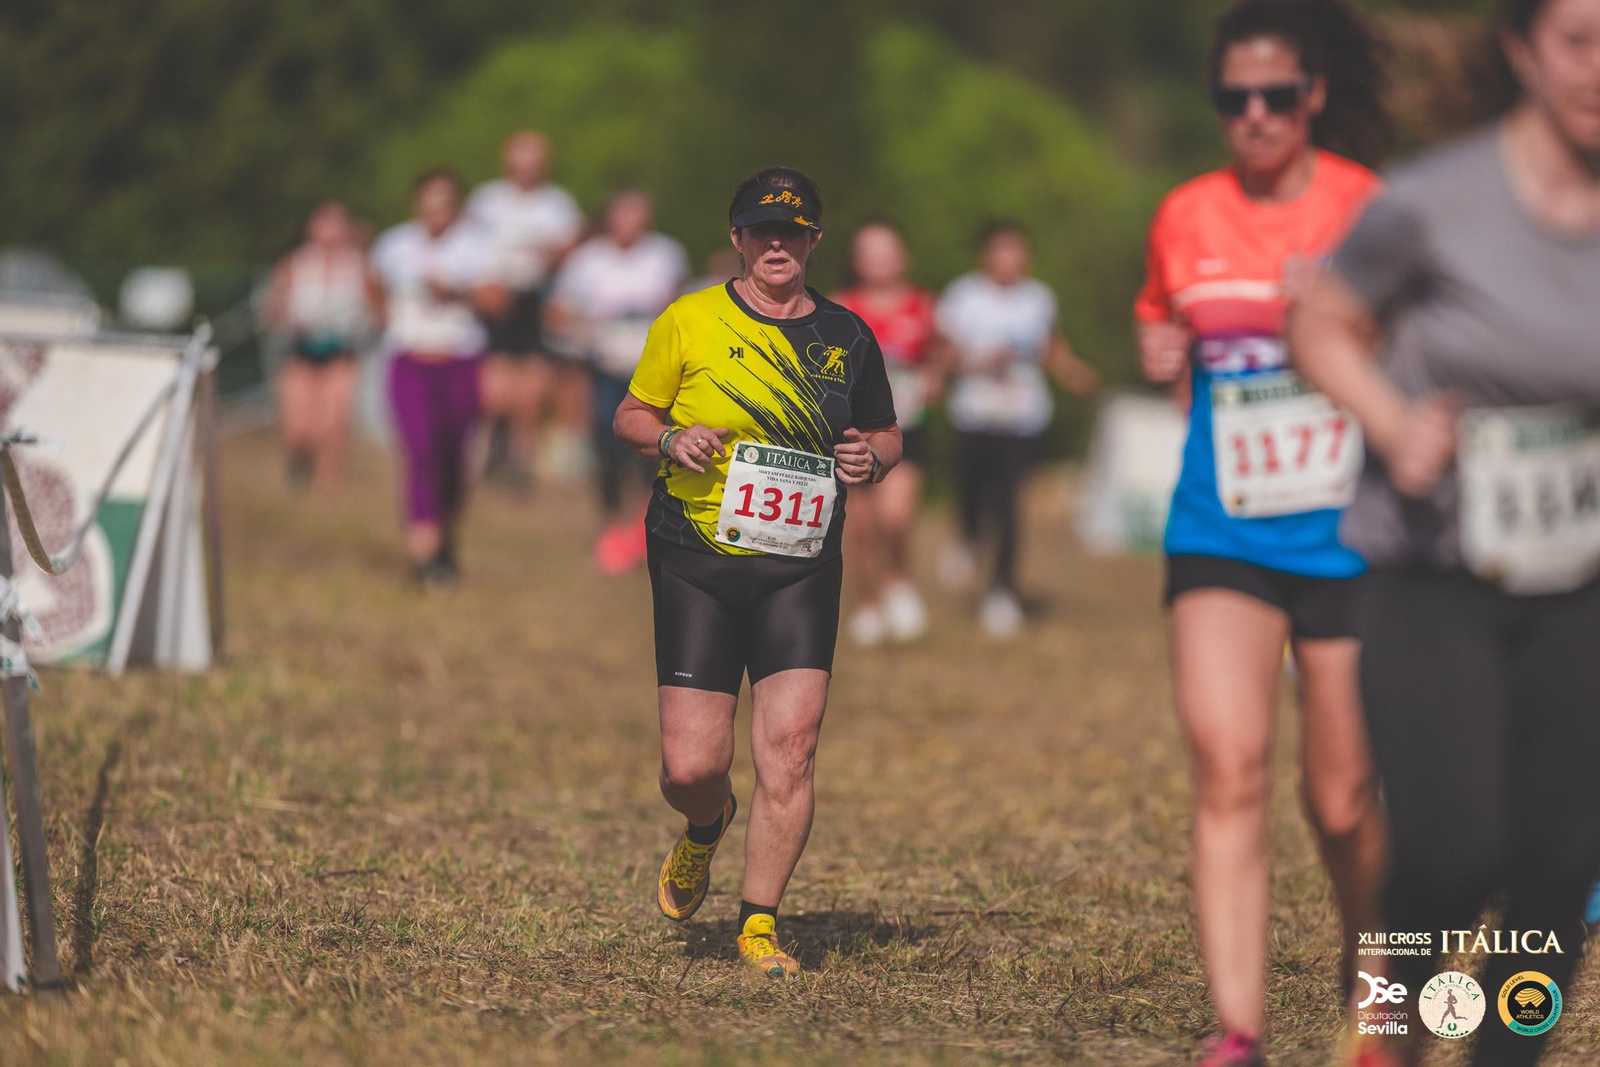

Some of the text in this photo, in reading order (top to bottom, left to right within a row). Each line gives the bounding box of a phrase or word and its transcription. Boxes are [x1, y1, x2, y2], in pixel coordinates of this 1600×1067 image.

[766, 451, 810, 470] ITÁLICA
[1230, 417, 1347, 477] 1177
[734, 483, 824, 528] 1311
